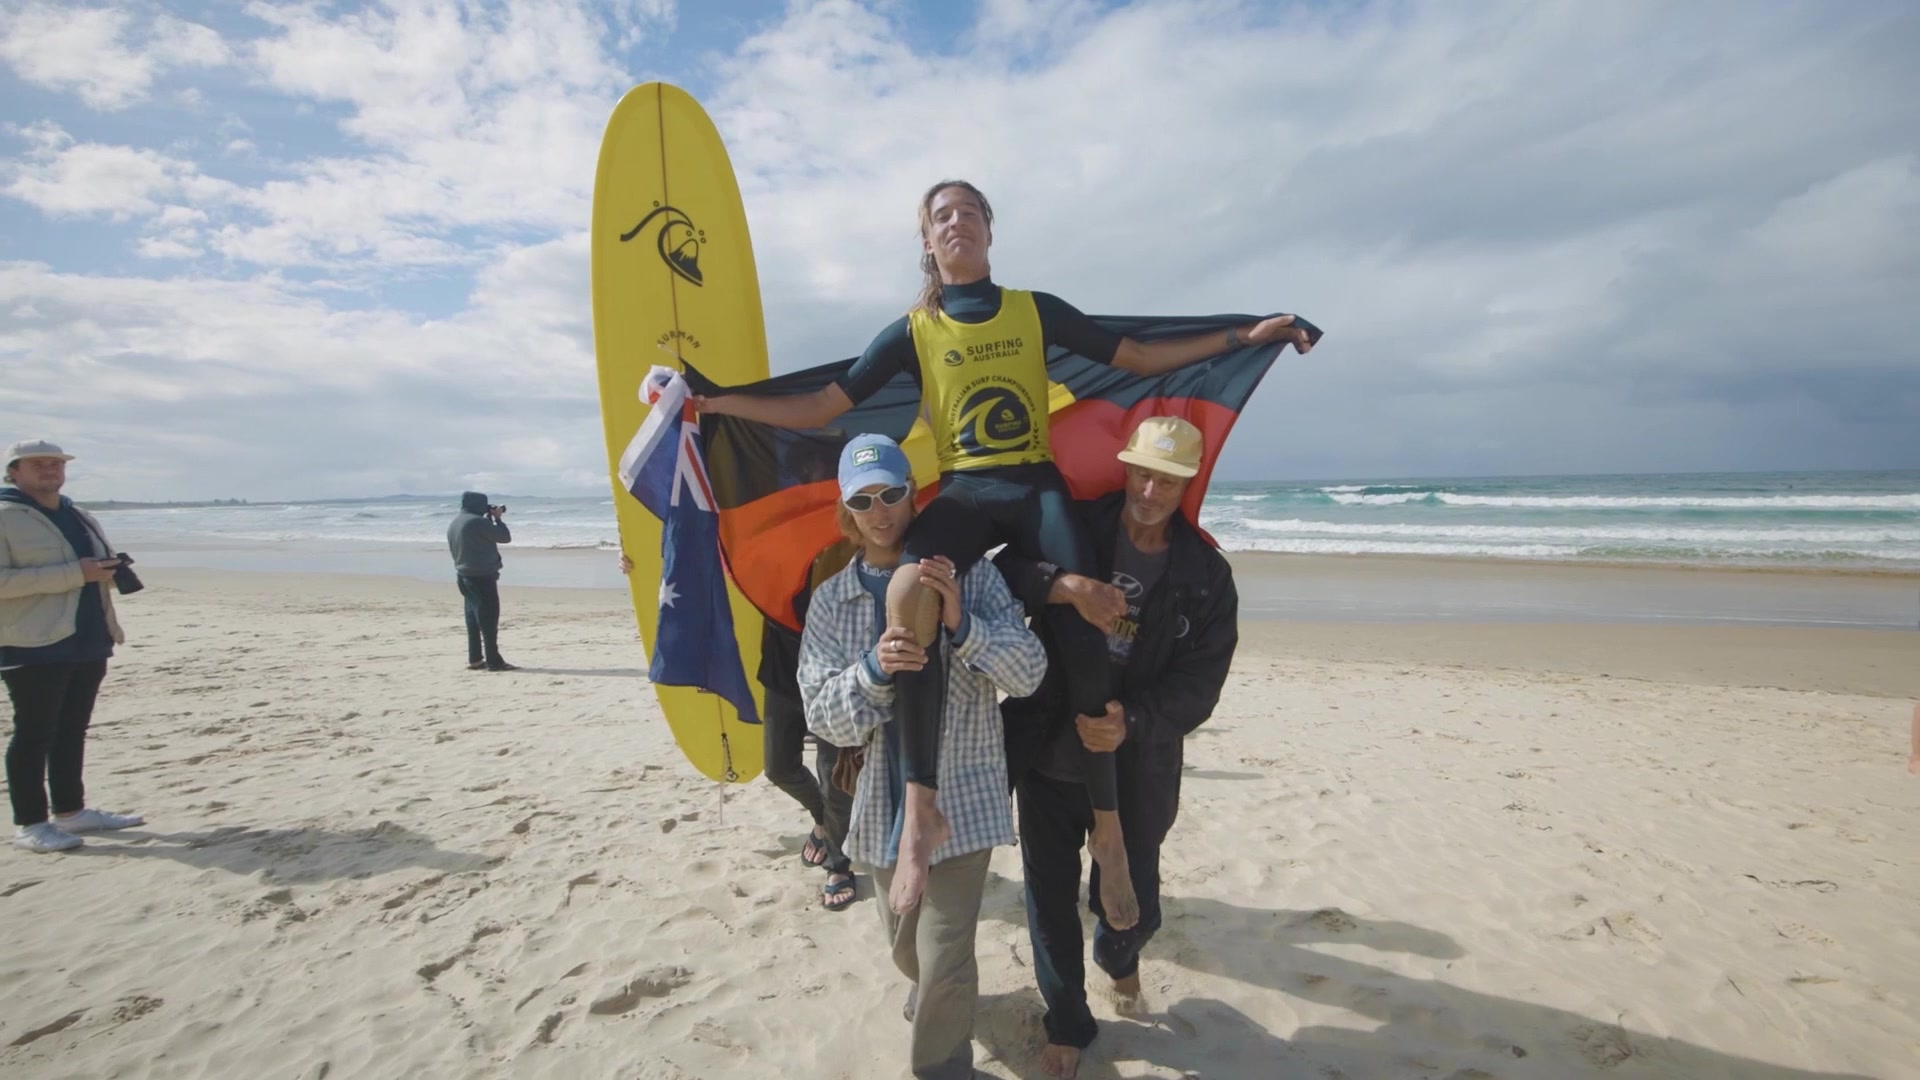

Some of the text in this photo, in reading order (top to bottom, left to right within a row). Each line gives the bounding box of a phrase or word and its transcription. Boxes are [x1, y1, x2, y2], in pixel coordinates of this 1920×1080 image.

[966, 337, 1024, 356] SURFING
[973, 349, 1020, 363] AUSTRALIA
[971, 375, 991, 388] SURF
